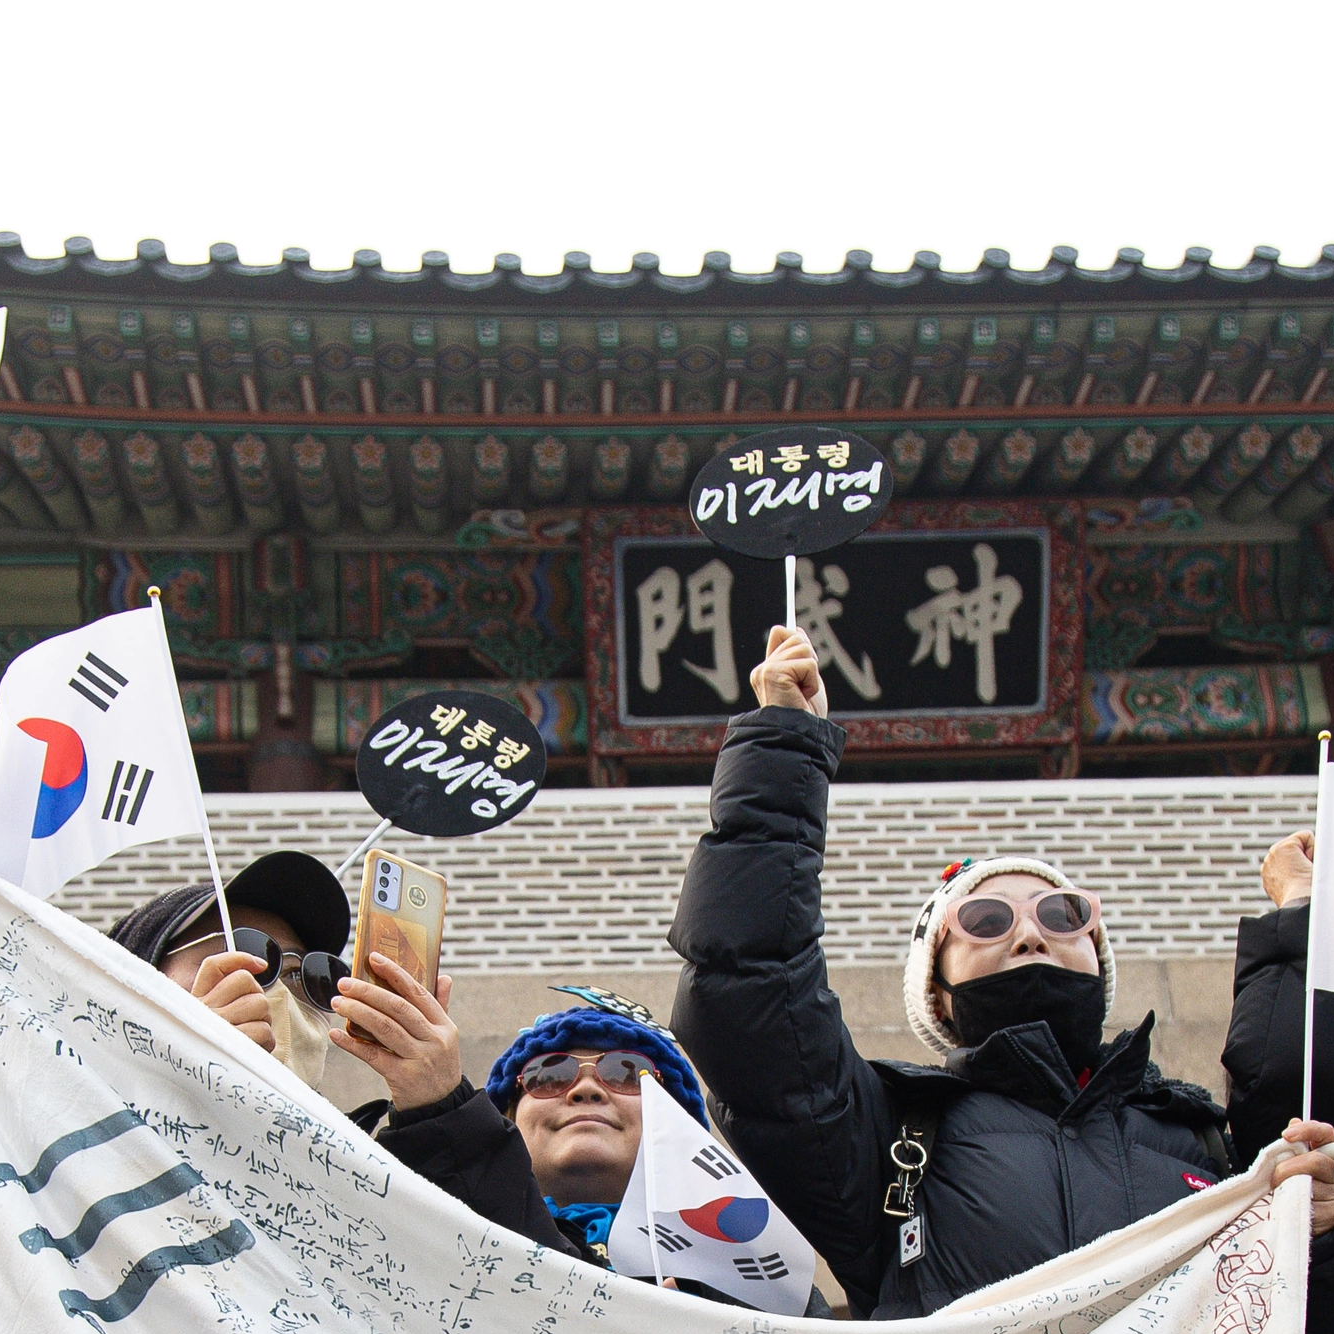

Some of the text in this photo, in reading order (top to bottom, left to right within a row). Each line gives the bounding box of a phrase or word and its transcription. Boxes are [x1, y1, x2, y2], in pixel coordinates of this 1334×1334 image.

[729, 442, 851, 475] 대통령
[695, 460, 883, 525] 이재명
[429, 702, 531, 769] 대통령
[369, 719, 536, 819] 이재명
